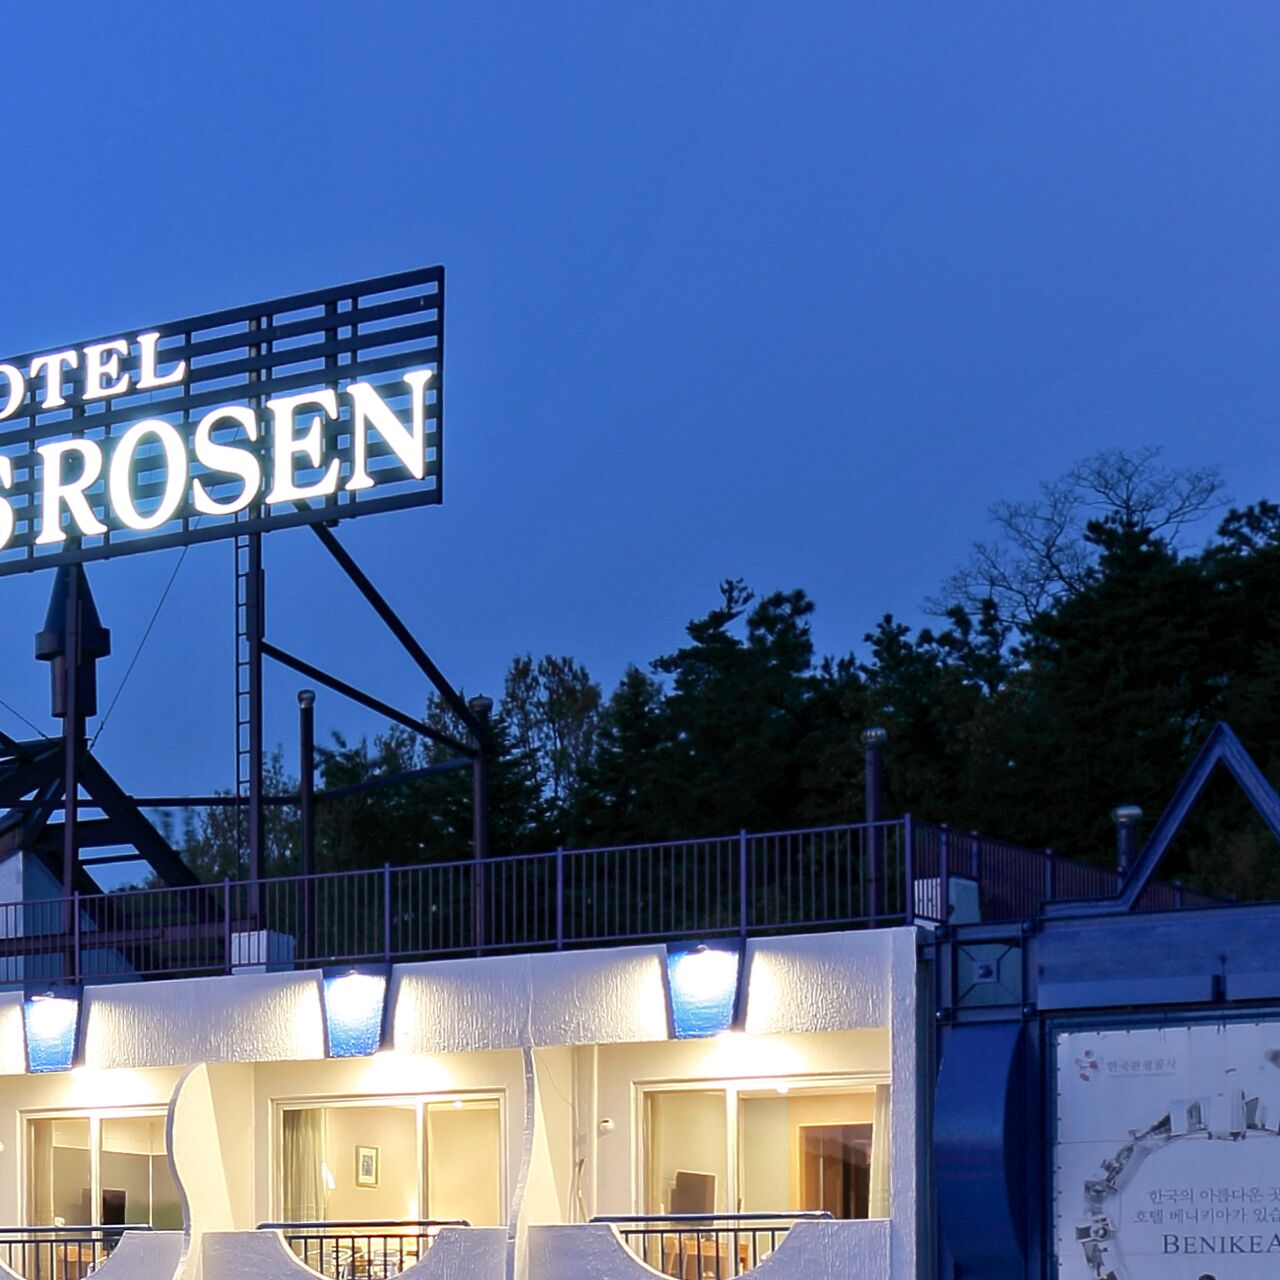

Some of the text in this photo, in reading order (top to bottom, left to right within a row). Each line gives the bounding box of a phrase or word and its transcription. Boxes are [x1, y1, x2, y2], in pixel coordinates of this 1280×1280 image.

[35, 369, 433, 546] ROSEN
[1148, 1187, 1194, 1205] 한국의
[1199, 1186, 1263, 1204] 아름다운
[1133, 1208, 1164, 1225] 호텔
[1169, 1206, 1248, 1224] 베니키아가
[1161, 1232, 1280, 1255] BENIKEA
